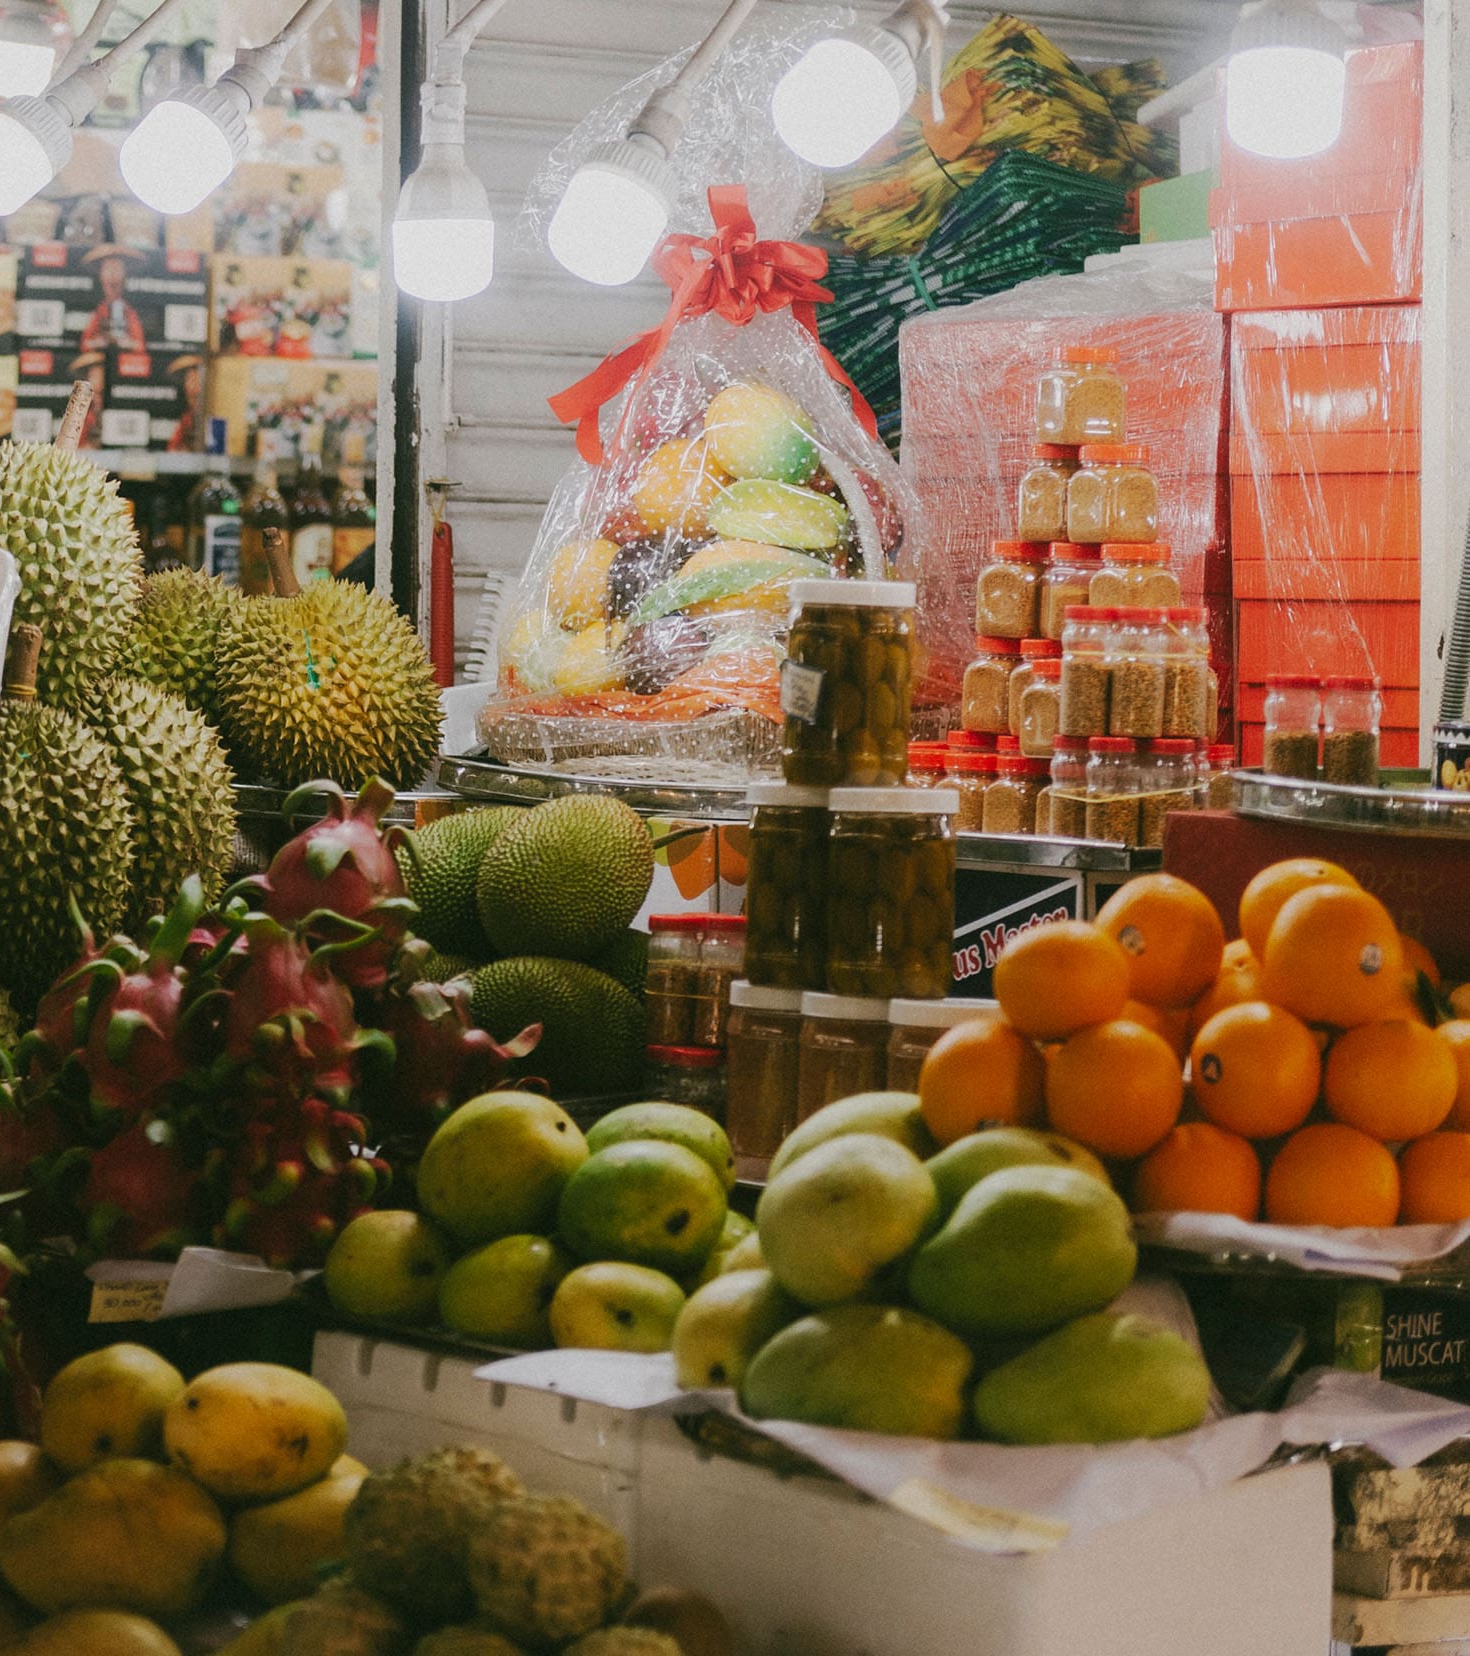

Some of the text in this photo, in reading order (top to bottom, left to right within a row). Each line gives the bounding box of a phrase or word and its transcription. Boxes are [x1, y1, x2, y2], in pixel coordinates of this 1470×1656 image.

[981, 906, 1069, 968] Mtr
[1385, 1312, 1443, 1339] SHINE
[1385, 1340, 1466, 1368] MUSCAT
